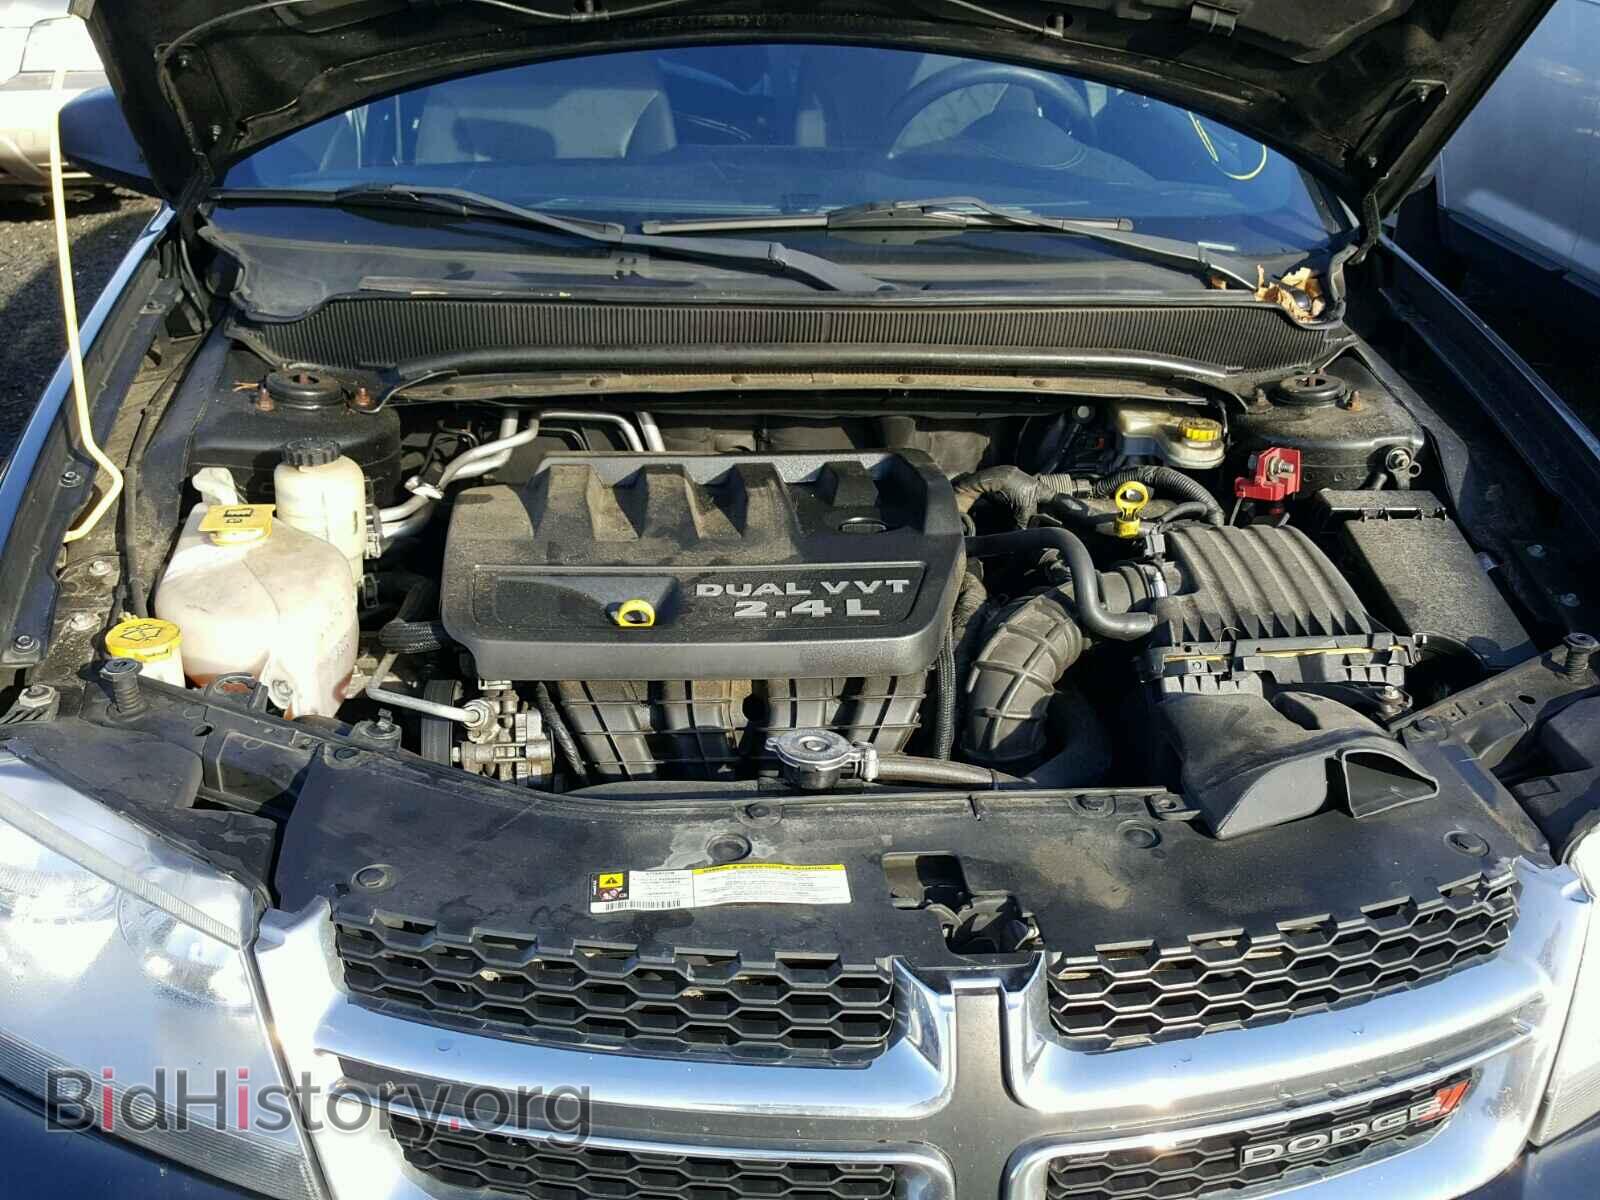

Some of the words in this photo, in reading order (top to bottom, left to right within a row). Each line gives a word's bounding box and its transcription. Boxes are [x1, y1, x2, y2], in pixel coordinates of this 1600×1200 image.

[695, 582, 812, 598] DUAL
[820, 579, 910, 595] VVT
[1242, 1097, 1442, 1166] DODGE
